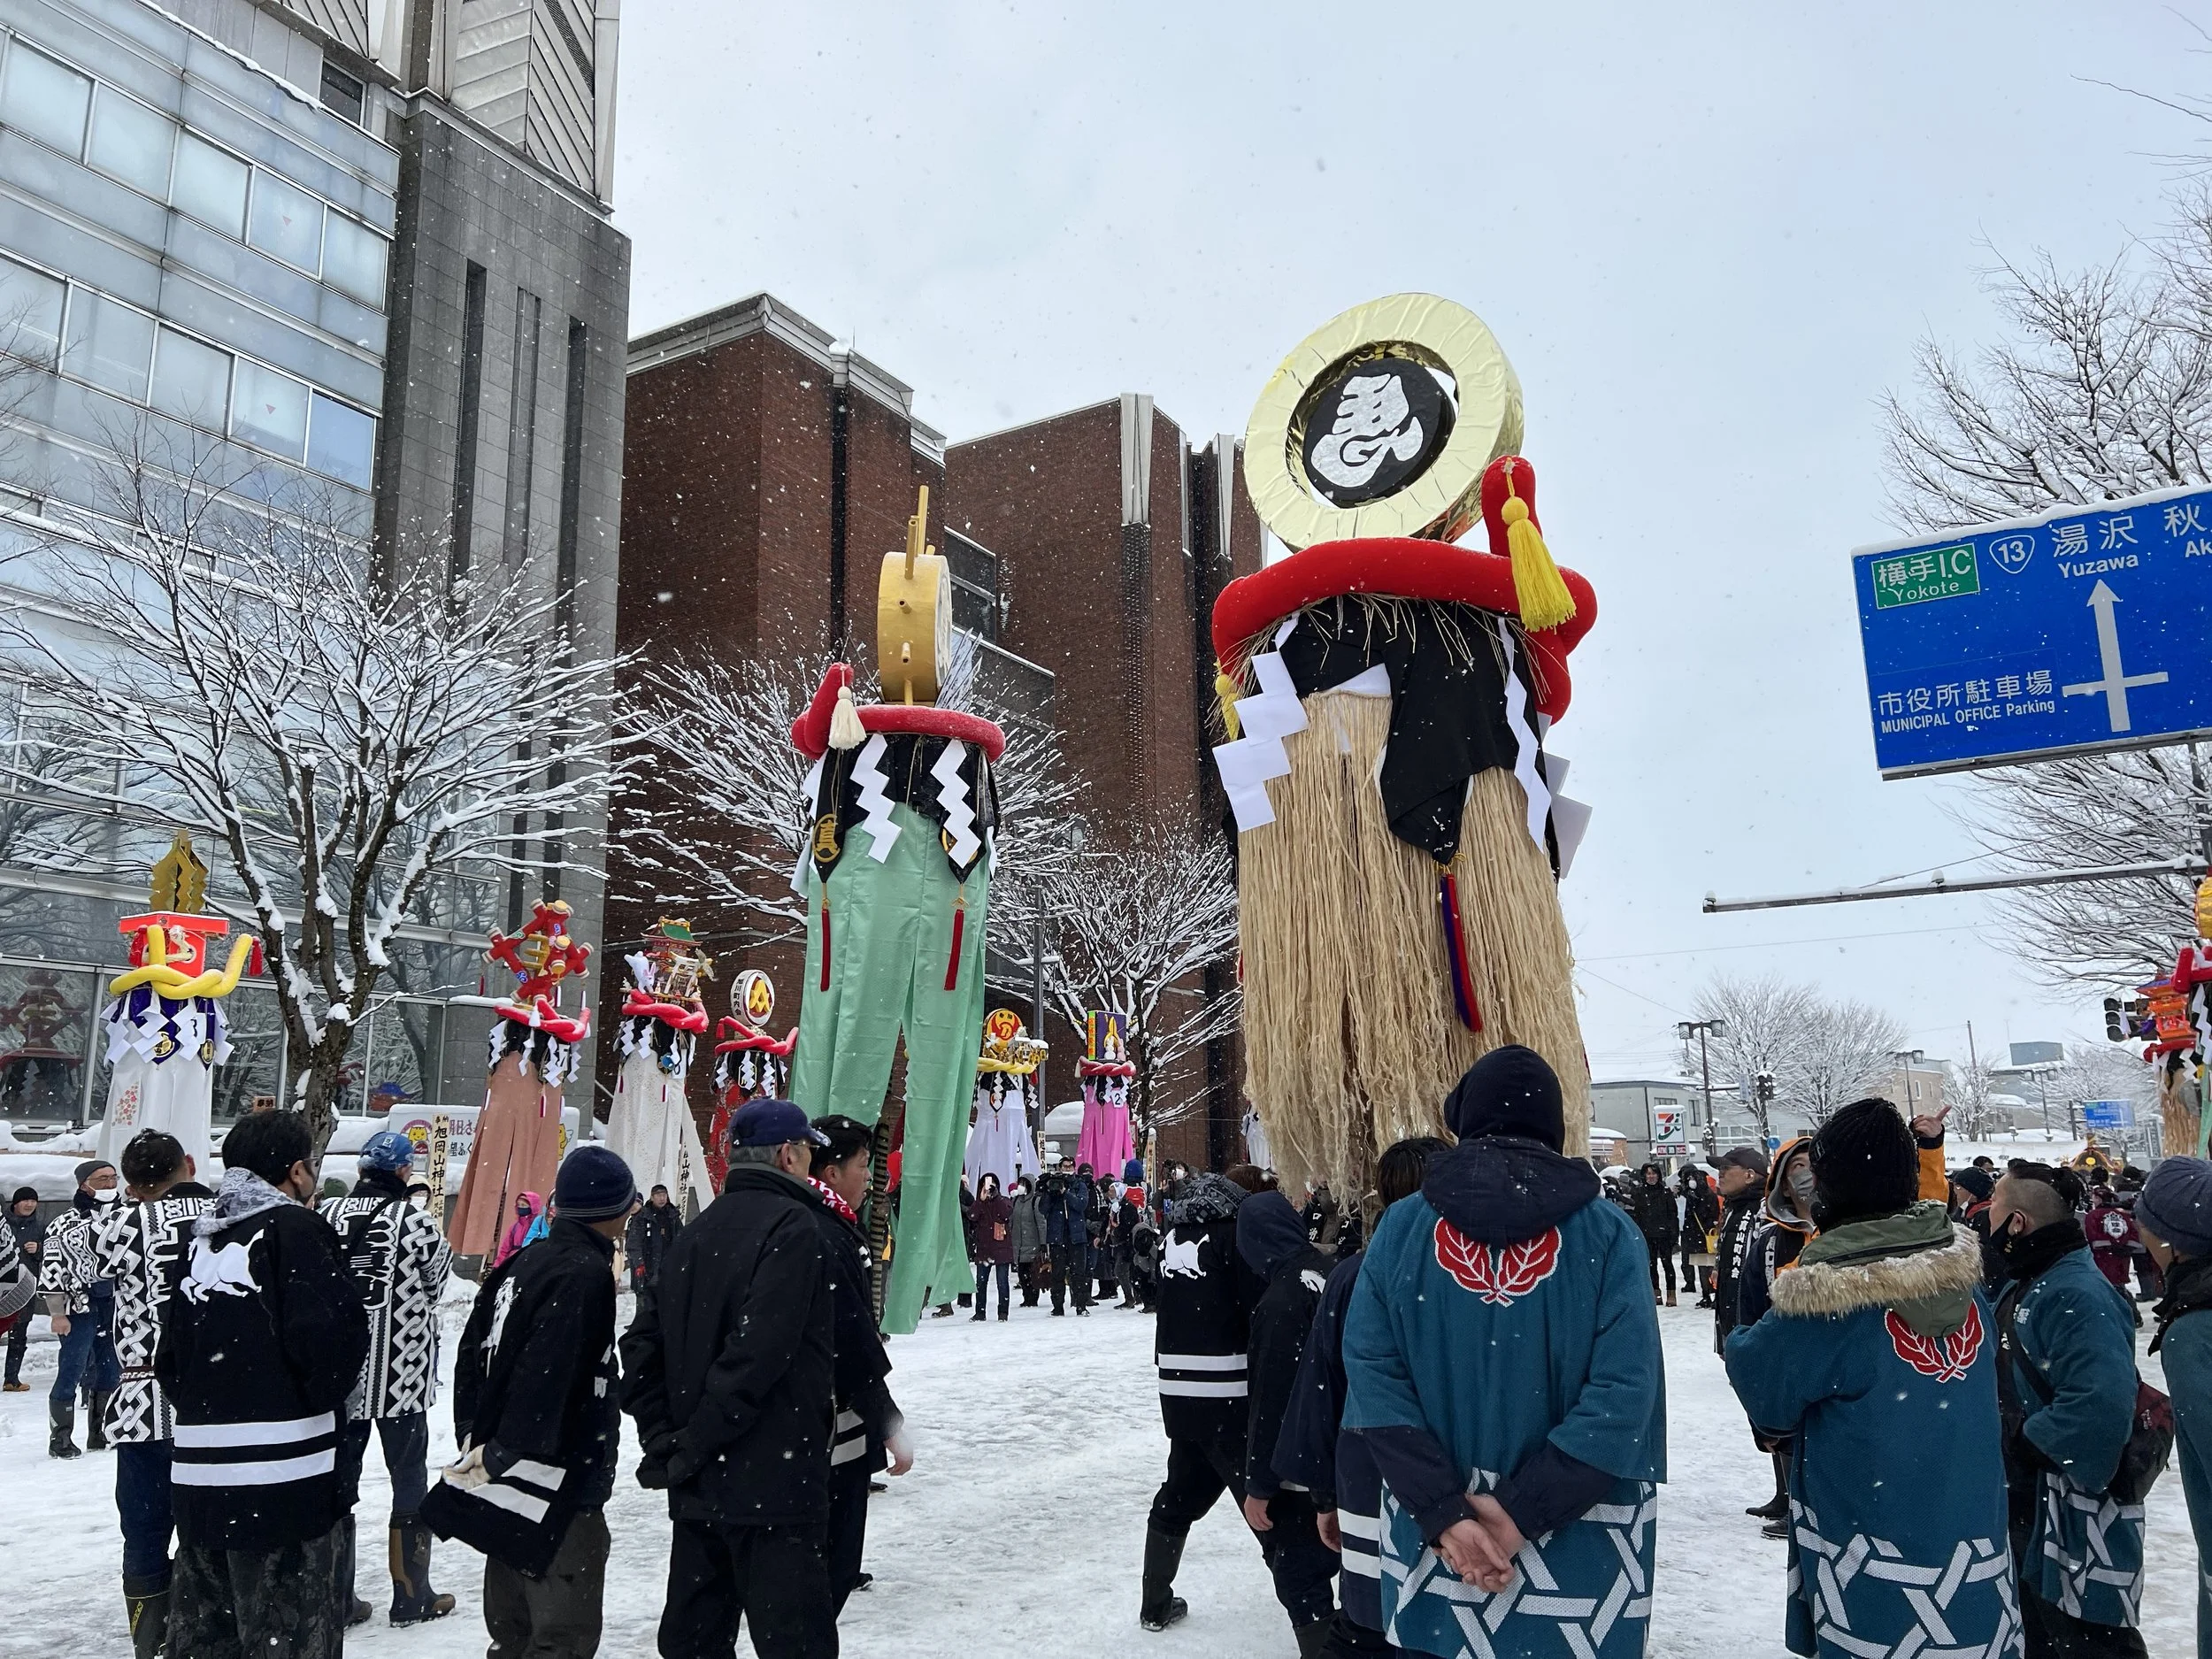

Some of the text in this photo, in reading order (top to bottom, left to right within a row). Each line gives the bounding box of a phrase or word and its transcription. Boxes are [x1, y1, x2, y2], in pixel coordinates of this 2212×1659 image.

[2052, 516, 2139, 557] 湯沢
[2163, 503, 2206, 537] 秋
[1998, 541, 2026, 564] 13
[2058, 554, 2139, 579] Yuzawa
[1887, 581, 1960, 602] Yokote
[1878, 670, 2053, 716] 市役所駐車場
[1881, 699, 2055, 733] MUNICIPAL OFFICE Parking
[1114, 1094, 1122, 1106] 2
[432, 1126, 448, 1197] 旭岡山神社
